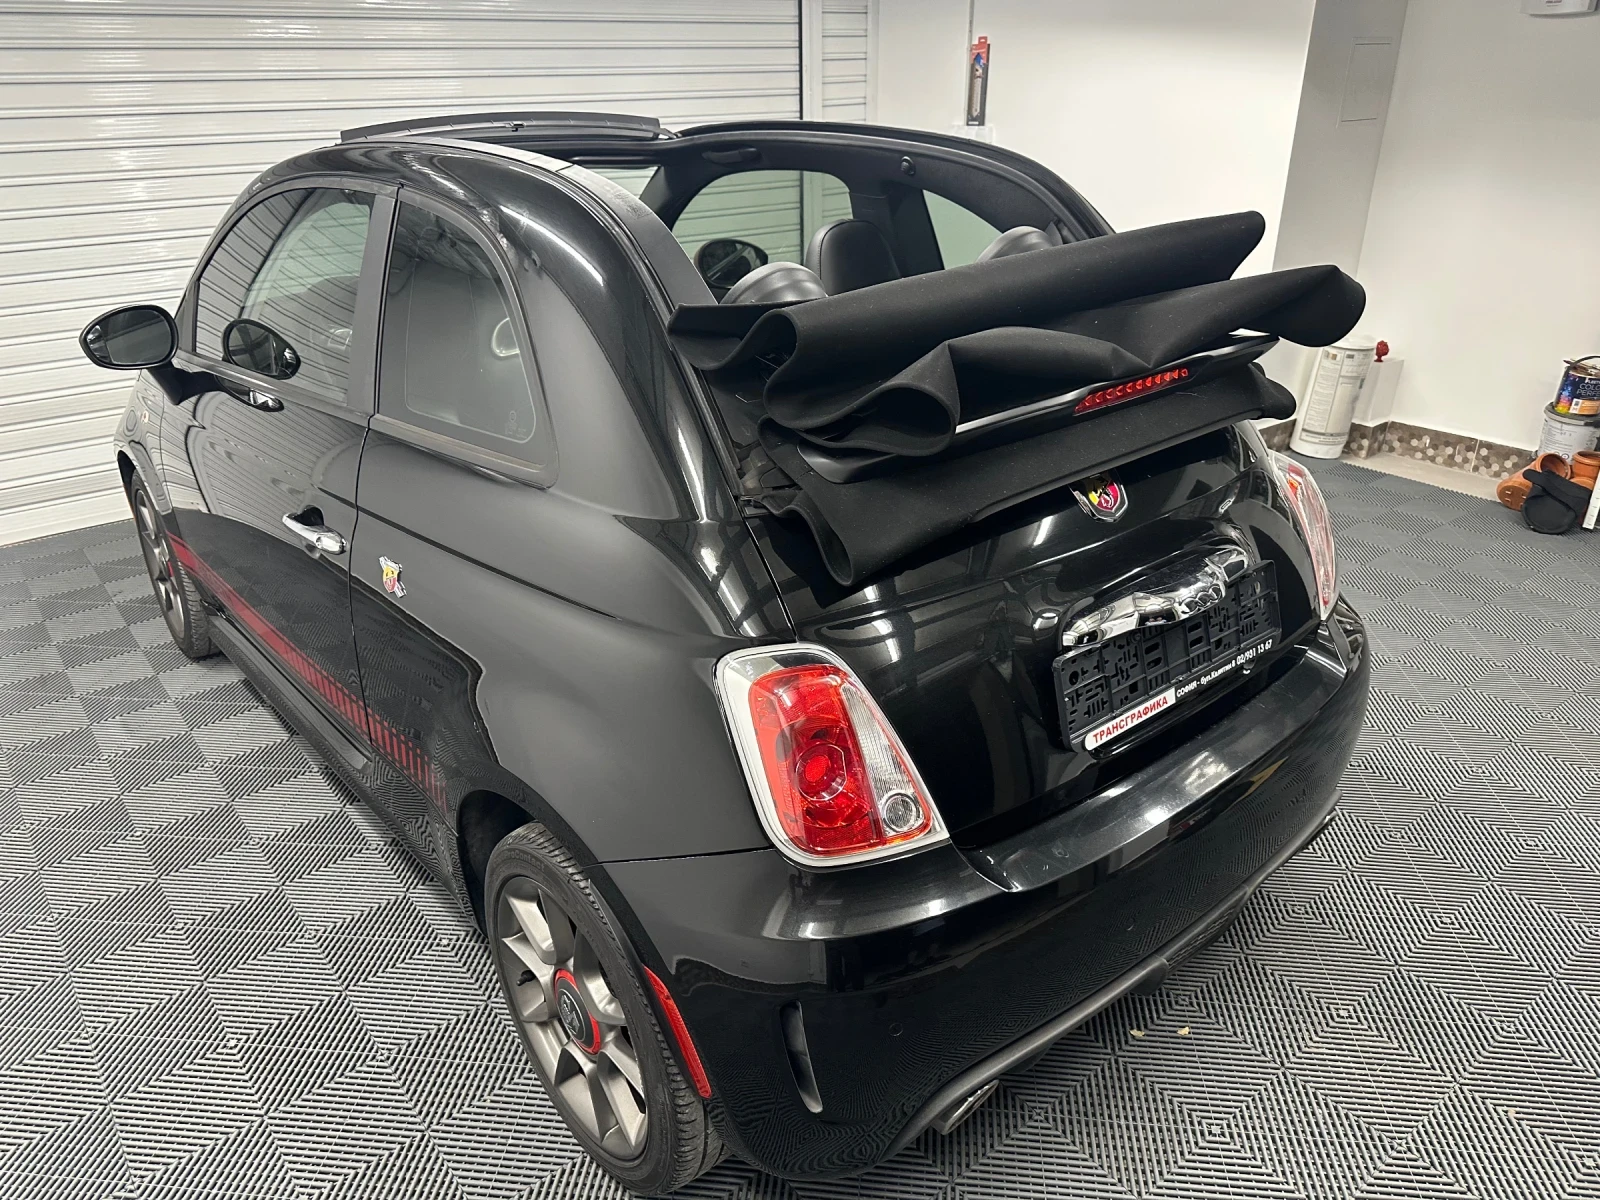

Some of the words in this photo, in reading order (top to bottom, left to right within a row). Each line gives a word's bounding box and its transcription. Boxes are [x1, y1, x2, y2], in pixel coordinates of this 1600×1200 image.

[1176, 680, 1198, 697] СОФИЯ
[1236, 647, 1257, 666] 02/931
[1257, 643, 1265, 654] 13
[1265, 639, 1273, 650] 67
[1093, 696, 1168, 744] ТРАНСГРАФИКА
